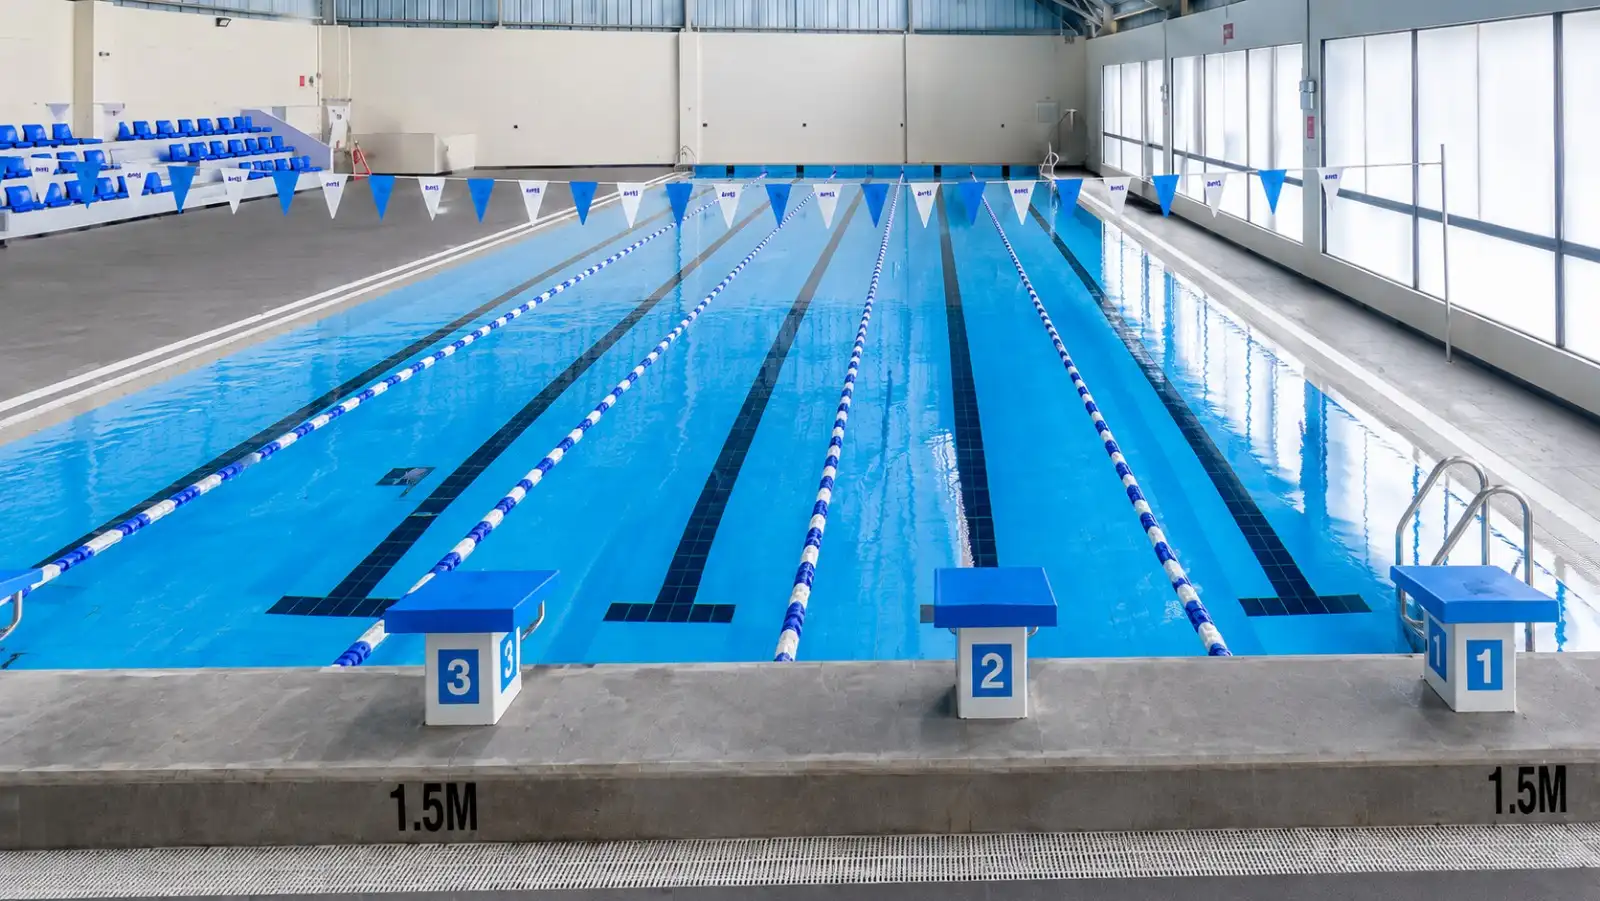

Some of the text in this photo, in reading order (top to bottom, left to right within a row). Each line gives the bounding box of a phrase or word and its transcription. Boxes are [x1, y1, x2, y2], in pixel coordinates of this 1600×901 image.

[504, 639, 514, 678] 3
[1433, 634, 1440, 668] 1
[1476, 648, 1492, 684] 1
[447, 658, 471, 695] 3
[981, 652, 1004, 688] 2
[390, 782, 478, 832] 1.5M
[1488, 765, 1567, 815] 1.5M
